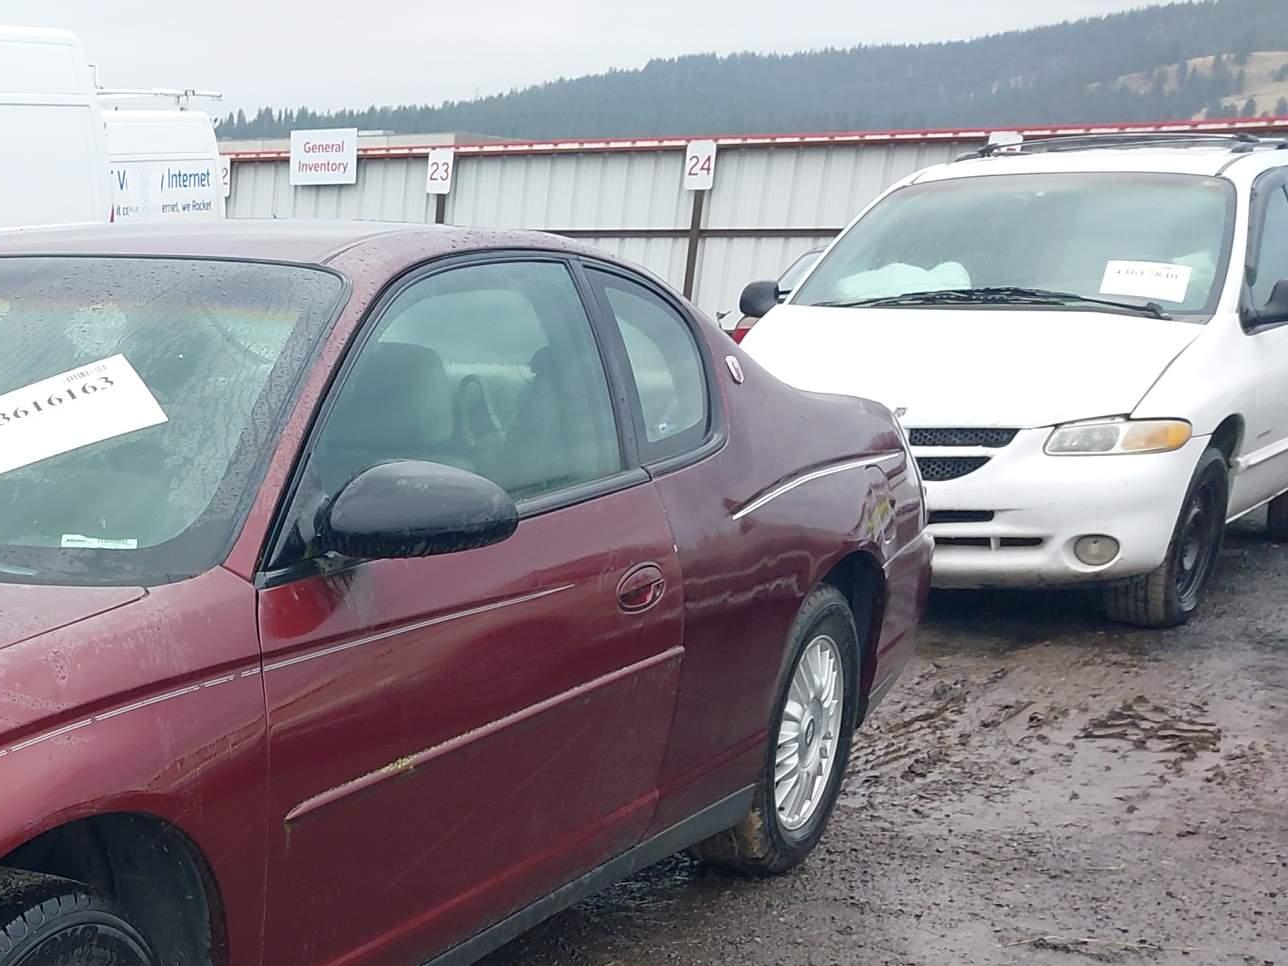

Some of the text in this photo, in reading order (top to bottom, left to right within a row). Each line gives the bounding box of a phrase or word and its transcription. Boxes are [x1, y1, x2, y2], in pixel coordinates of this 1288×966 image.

[303, 140, 345, 154] General
[298, 160, 349, 174] Inventory
[429, 161, 450, 182] 23
[687, 155, 712, 176] 24
[167, 167, 211, 189] Internet
